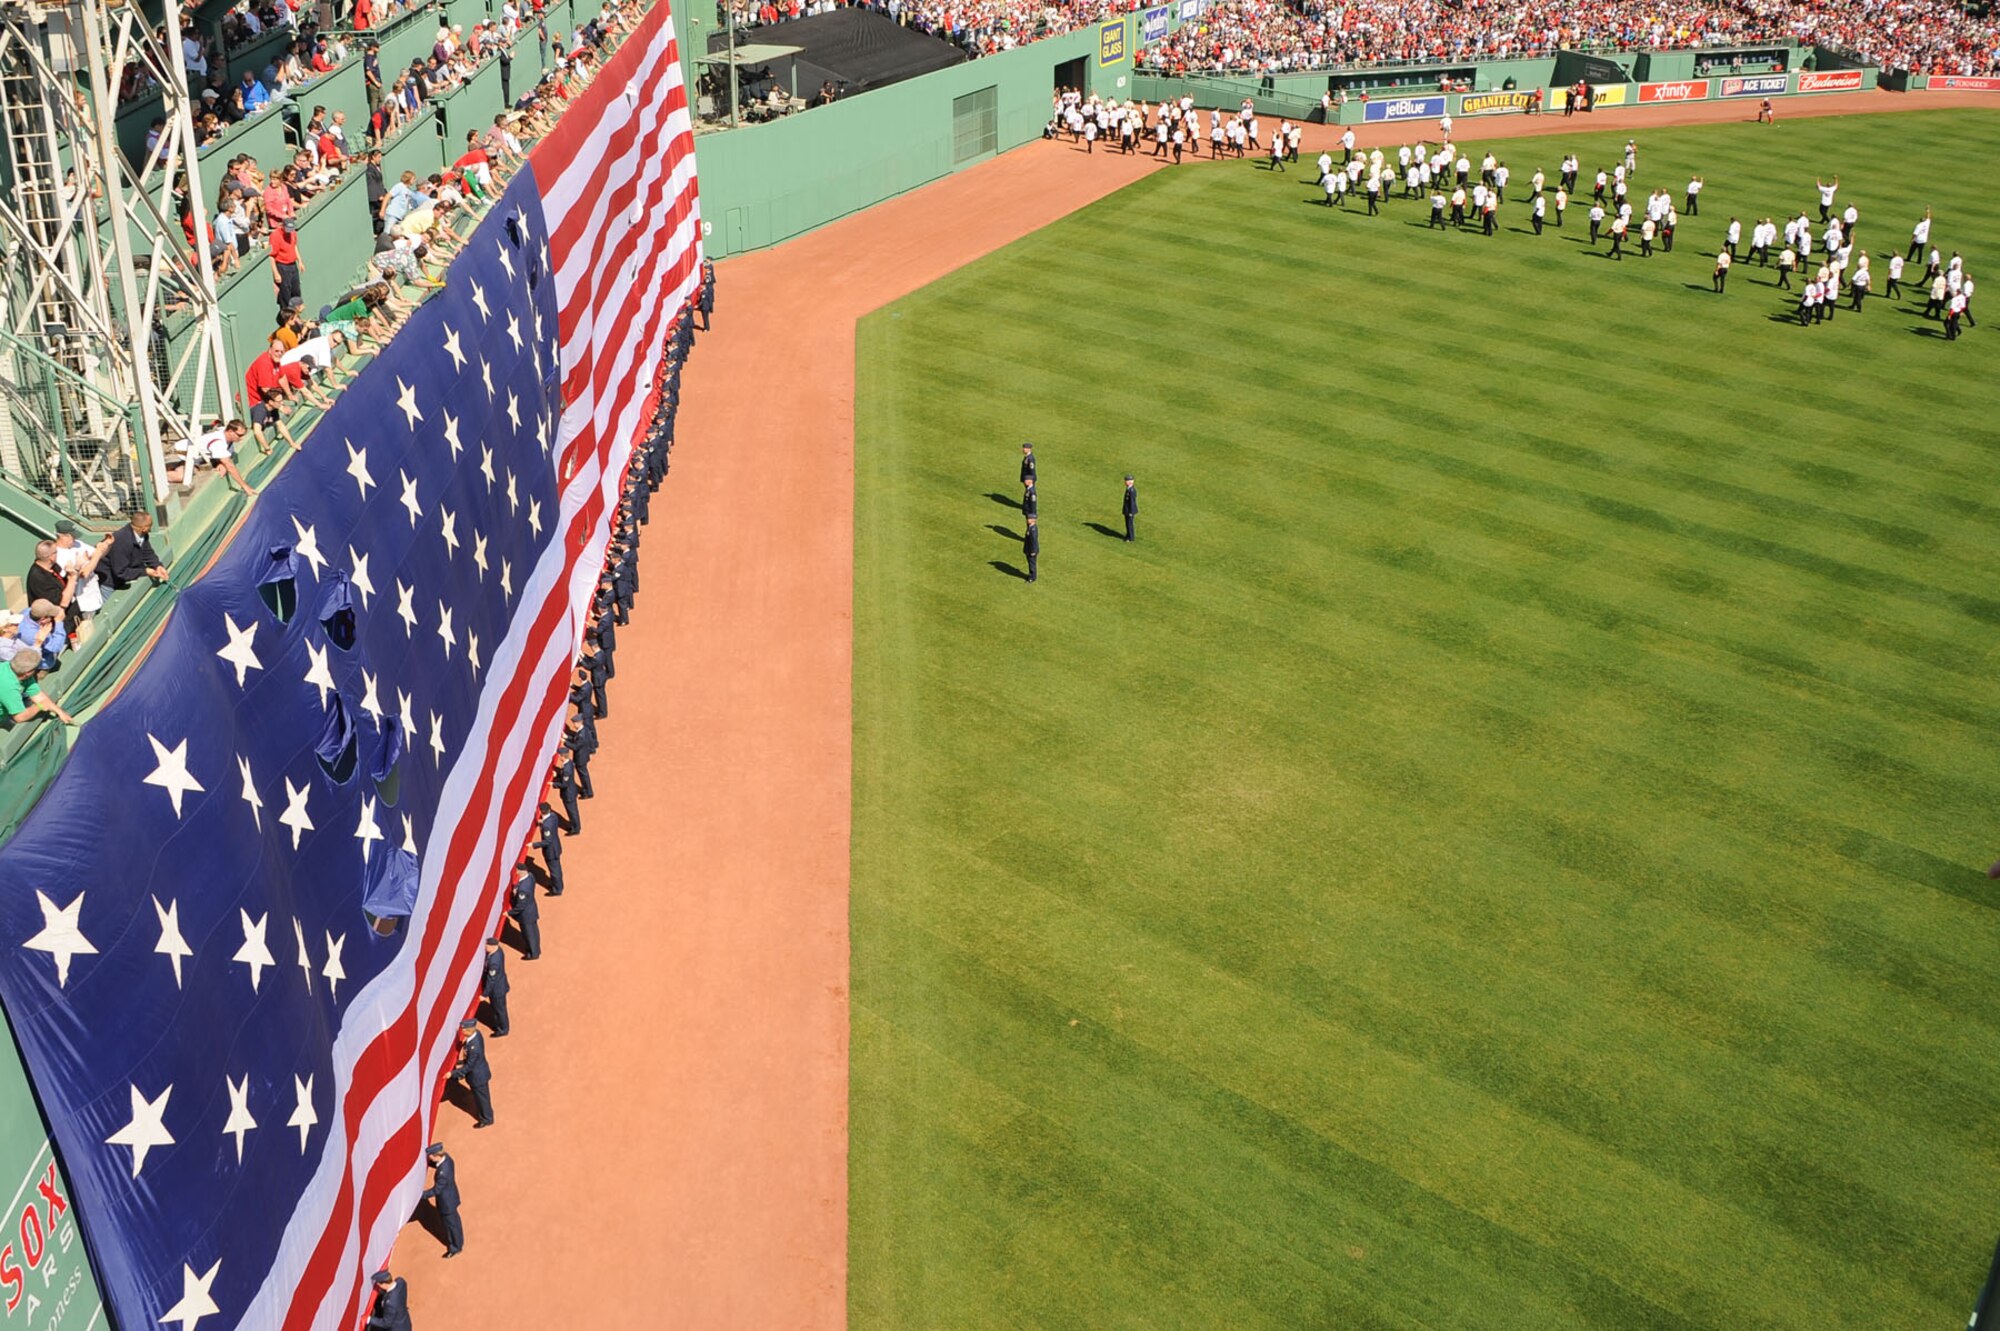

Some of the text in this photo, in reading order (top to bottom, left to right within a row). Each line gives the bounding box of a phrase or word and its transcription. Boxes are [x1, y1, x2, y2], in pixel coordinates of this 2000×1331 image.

[1103, 28, 1121, 43] GIANT
[1102, 42, 1122, 58] GLASS
[1743, 80, 1760, 91] ACE
[1760, 79, 1786, 90] TICKET
[1800, 76, 1860, 89] Budweiser
[1654, 83, 1693, 100] xfinity
[1384, 101, 1426, 119] jetBlue
[1464, 94, 1511, 112] GRANITE
[0, 1158, 68, 1318] SOX
